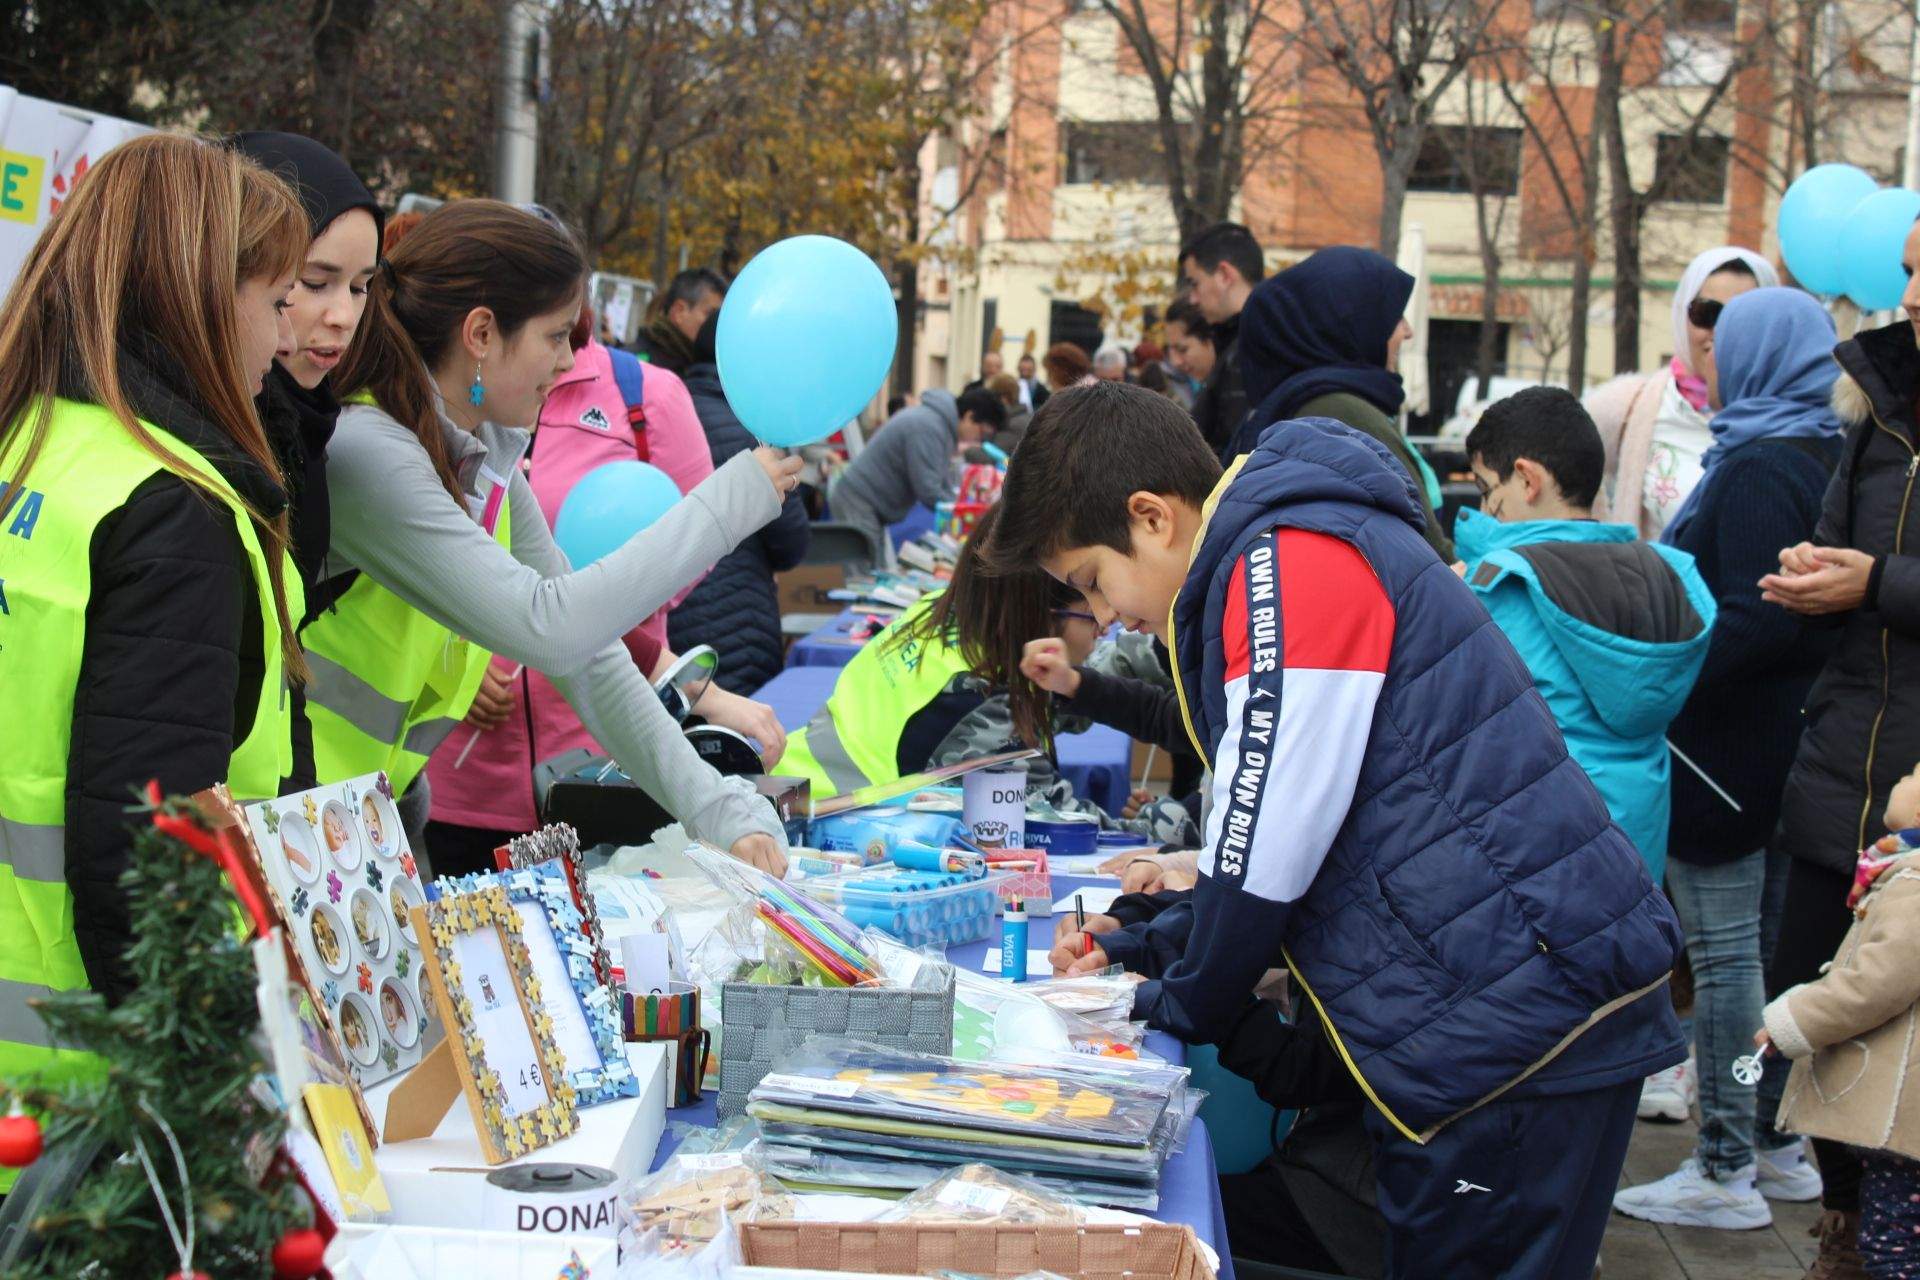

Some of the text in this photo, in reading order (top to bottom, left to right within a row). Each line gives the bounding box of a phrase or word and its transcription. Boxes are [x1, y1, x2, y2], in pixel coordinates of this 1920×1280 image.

[1250, 546, 1274, 602] OWN
[1252, 606, 1277, 673] RULES
[1220, 709, 1274, 876] MY OWN RULES
[1003, 933, 1016, 968] BBVA
[517, 1195, 618, 1233] DONAT
